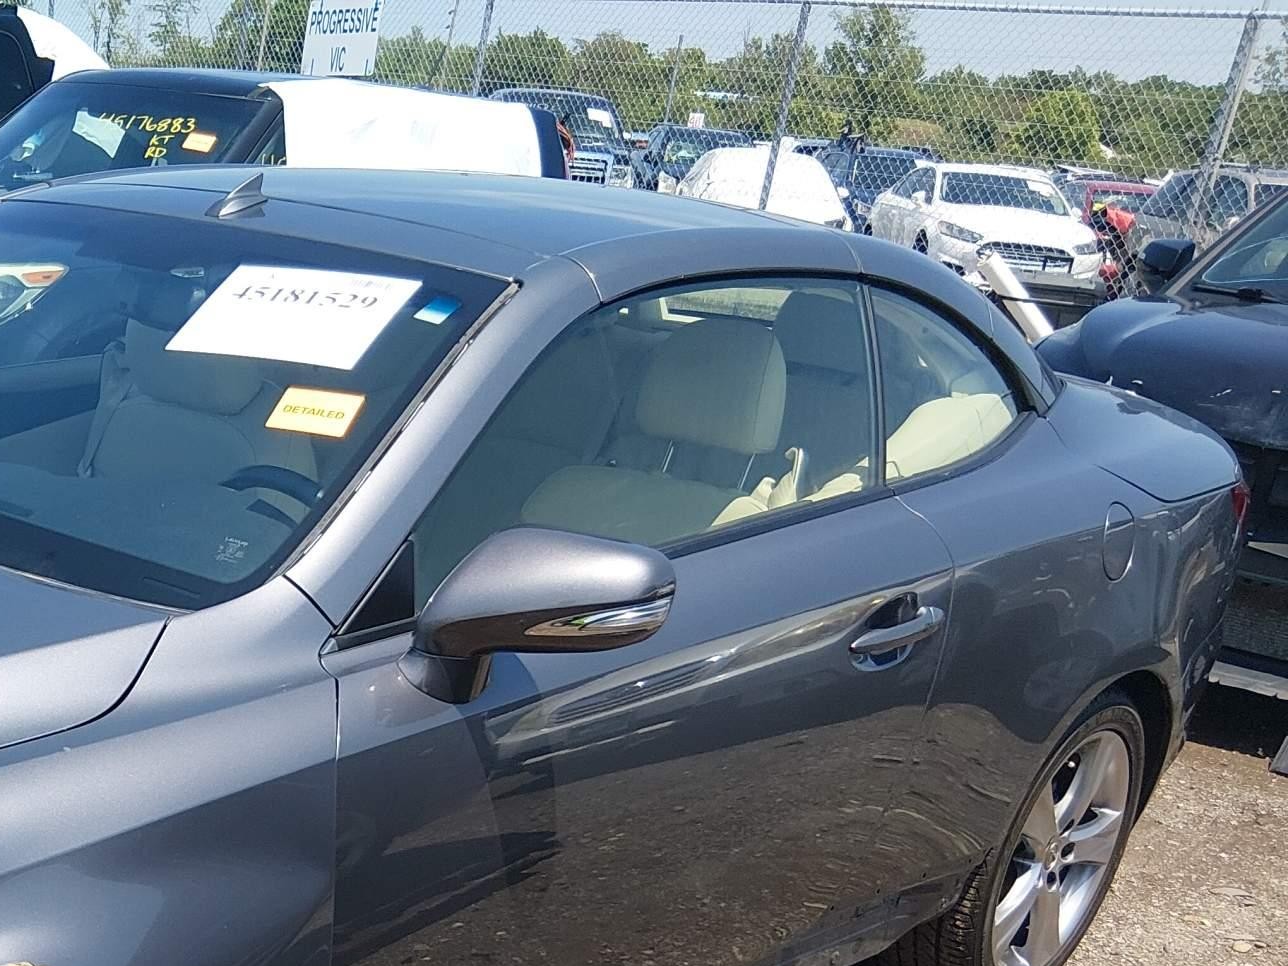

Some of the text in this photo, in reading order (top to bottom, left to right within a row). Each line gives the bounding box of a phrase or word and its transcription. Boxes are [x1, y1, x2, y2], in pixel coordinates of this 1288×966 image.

[309, 8, 379, 35] PROGRESSIVE
[329, 46, 346, 72] VIC
[98, 112, 196, 133] 45176883
[144, 147, 167, 158] RD
[231, 285, 379, 309] 45181529
[283, 404, 345, 420] DETAILED
